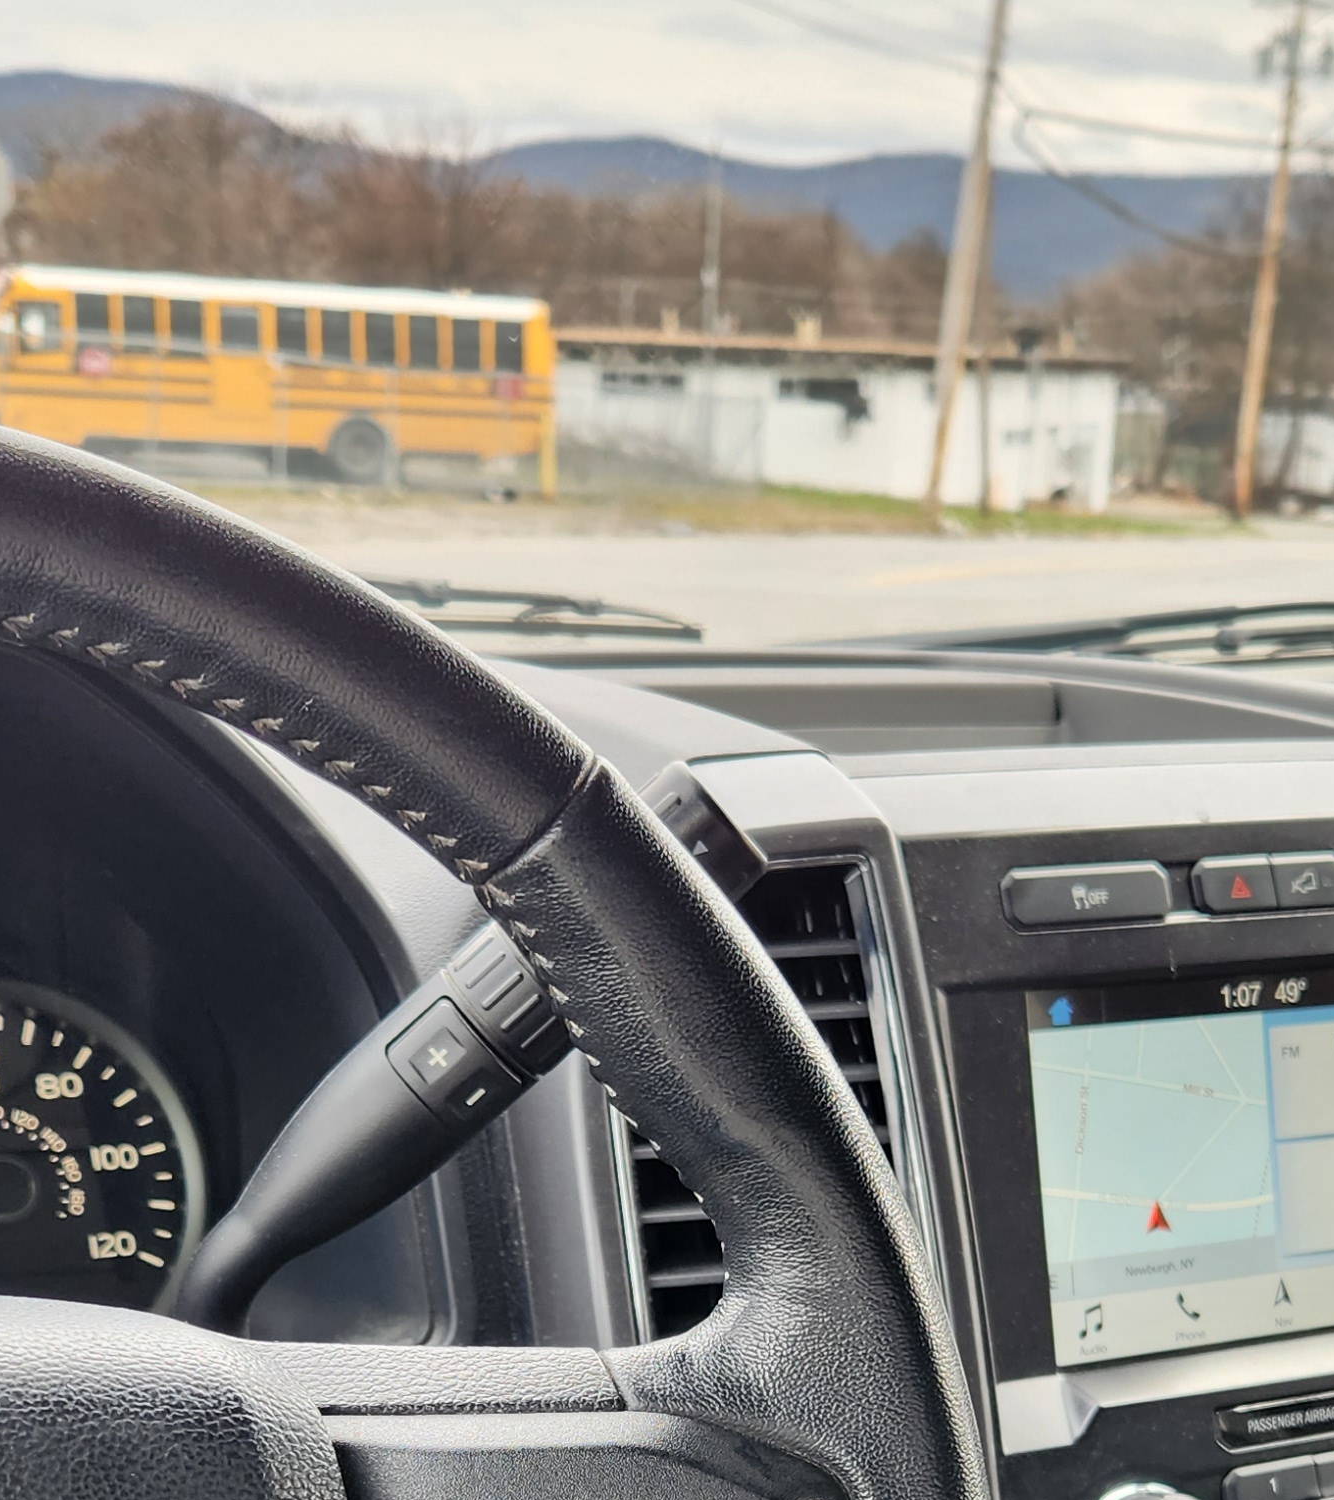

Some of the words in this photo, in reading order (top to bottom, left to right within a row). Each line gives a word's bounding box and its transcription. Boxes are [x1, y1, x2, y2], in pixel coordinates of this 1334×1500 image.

[1220, 981, 1262, 1009] 1:07
[34, 1071, 84, 1100] 80
[10, 1107, 40, 1131] 120
[89, 1143, 139, 1172] 100
[87, 1230, 137, 1260] 120
[1180, 1257, 1196, 1270] NY
[1247, 1411, 1303, 1434] PASSENGER
